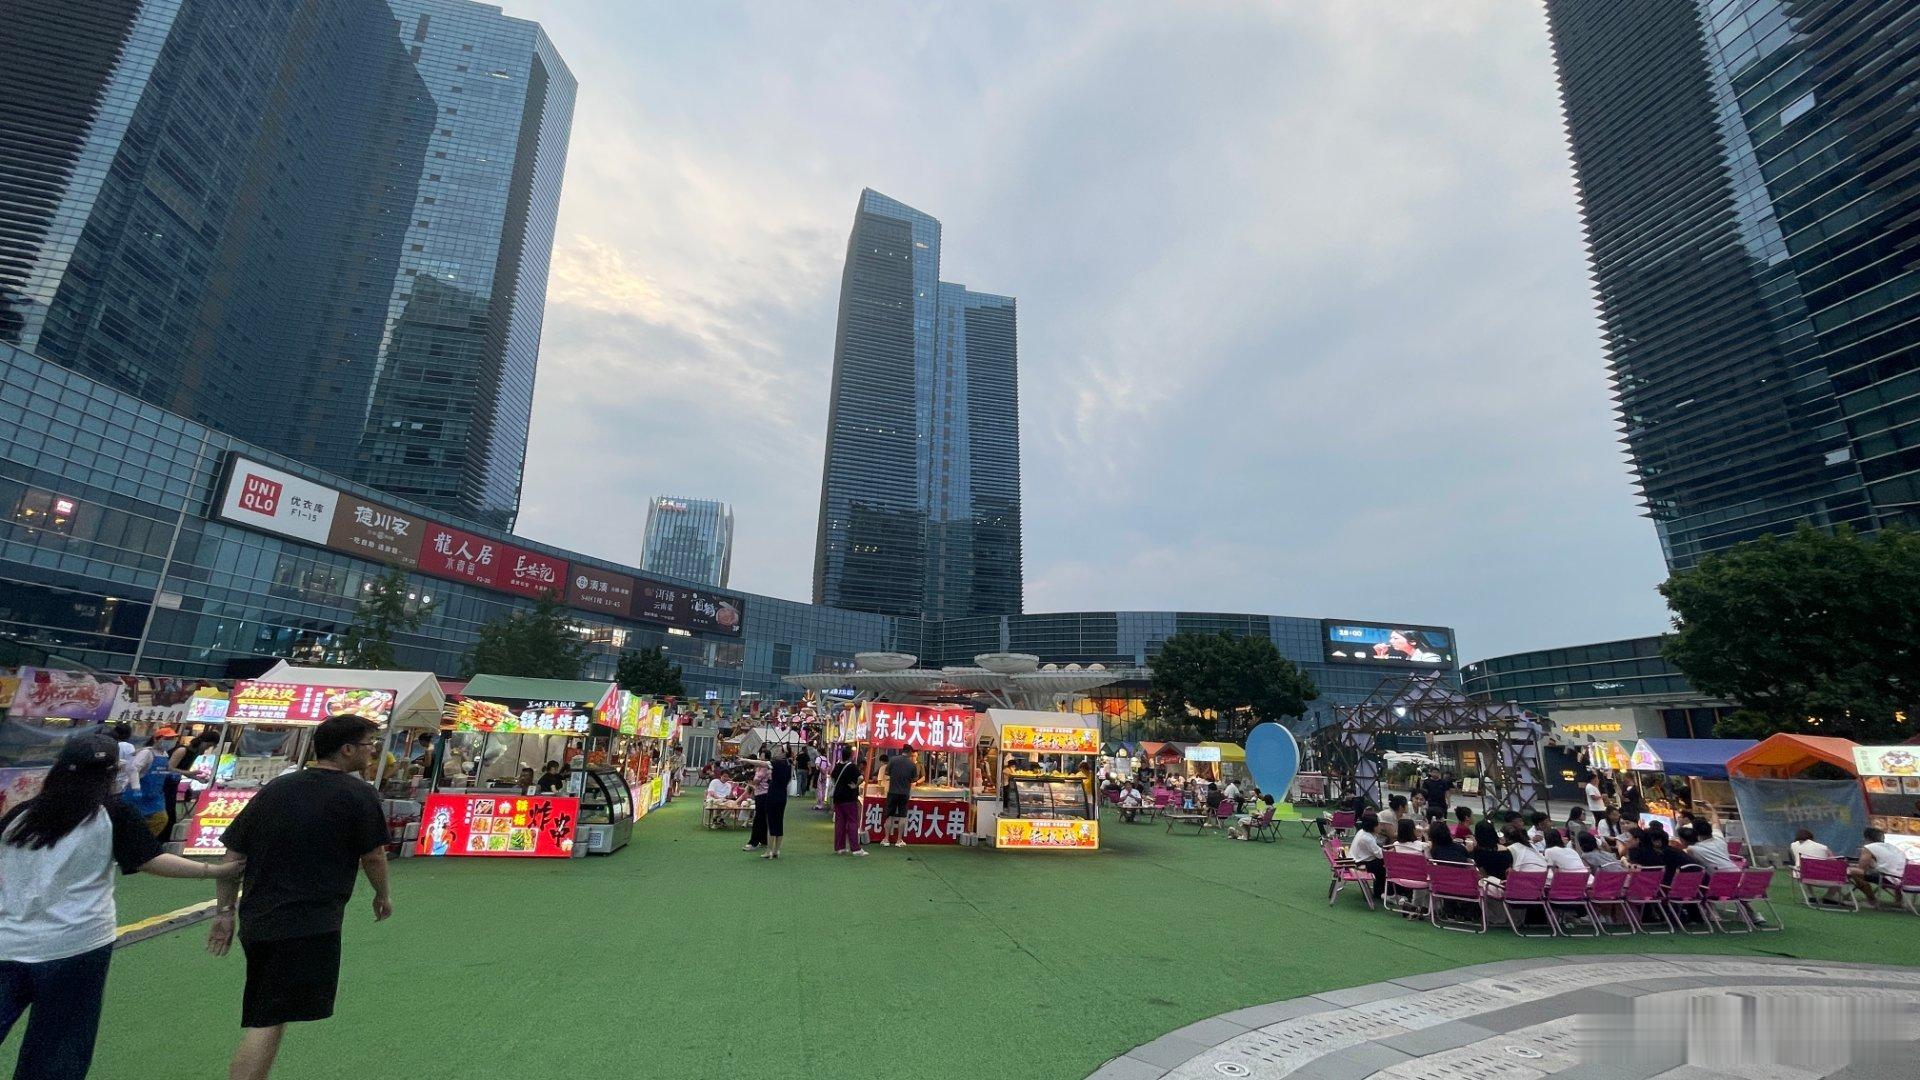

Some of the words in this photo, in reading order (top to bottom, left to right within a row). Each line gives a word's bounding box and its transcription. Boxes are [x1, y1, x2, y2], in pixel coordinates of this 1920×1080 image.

[249, 478, 276, 497] UNI
[244, 495, 274, 511] QLO
[291, 496, 325, 514] 优衣库
[291, 509, 317, 522] F1-15
[355, 505, 411, 536] 德川家
[433, 532, 493, 566] 龍人居
[235, 685, 301, 701] 麻辣烫
[874, 709, 965, 748] 东北大油边
[195, 798, 250, 816] 麻辣
[865, 803, 966, 840] 纯肉大串
